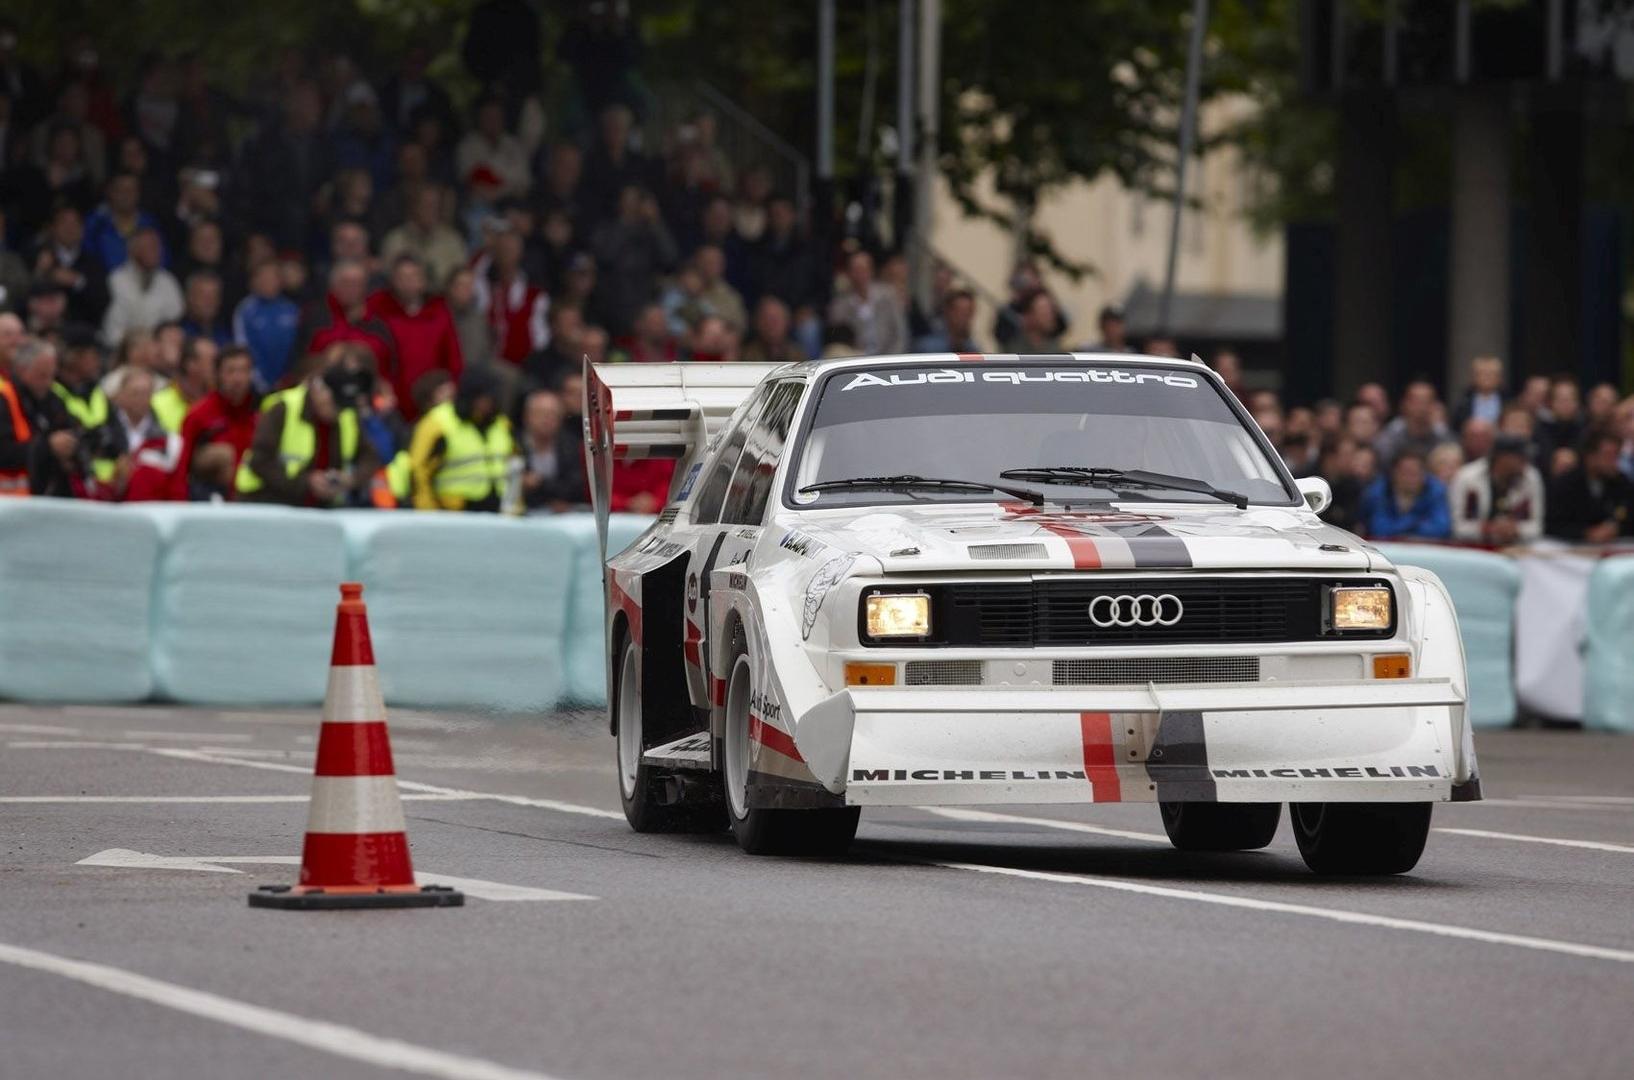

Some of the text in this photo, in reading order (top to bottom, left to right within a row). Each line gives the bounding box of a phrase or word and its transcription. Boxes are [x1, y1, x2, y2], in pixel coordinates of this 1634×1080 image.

[841, 369, 1198, 392] Audi quattro
[763, 694, 781, 721] Sport
[853, 769, 1087, 781] MICHELIN
[1212, 765, 1441, 778] MICHELIN
